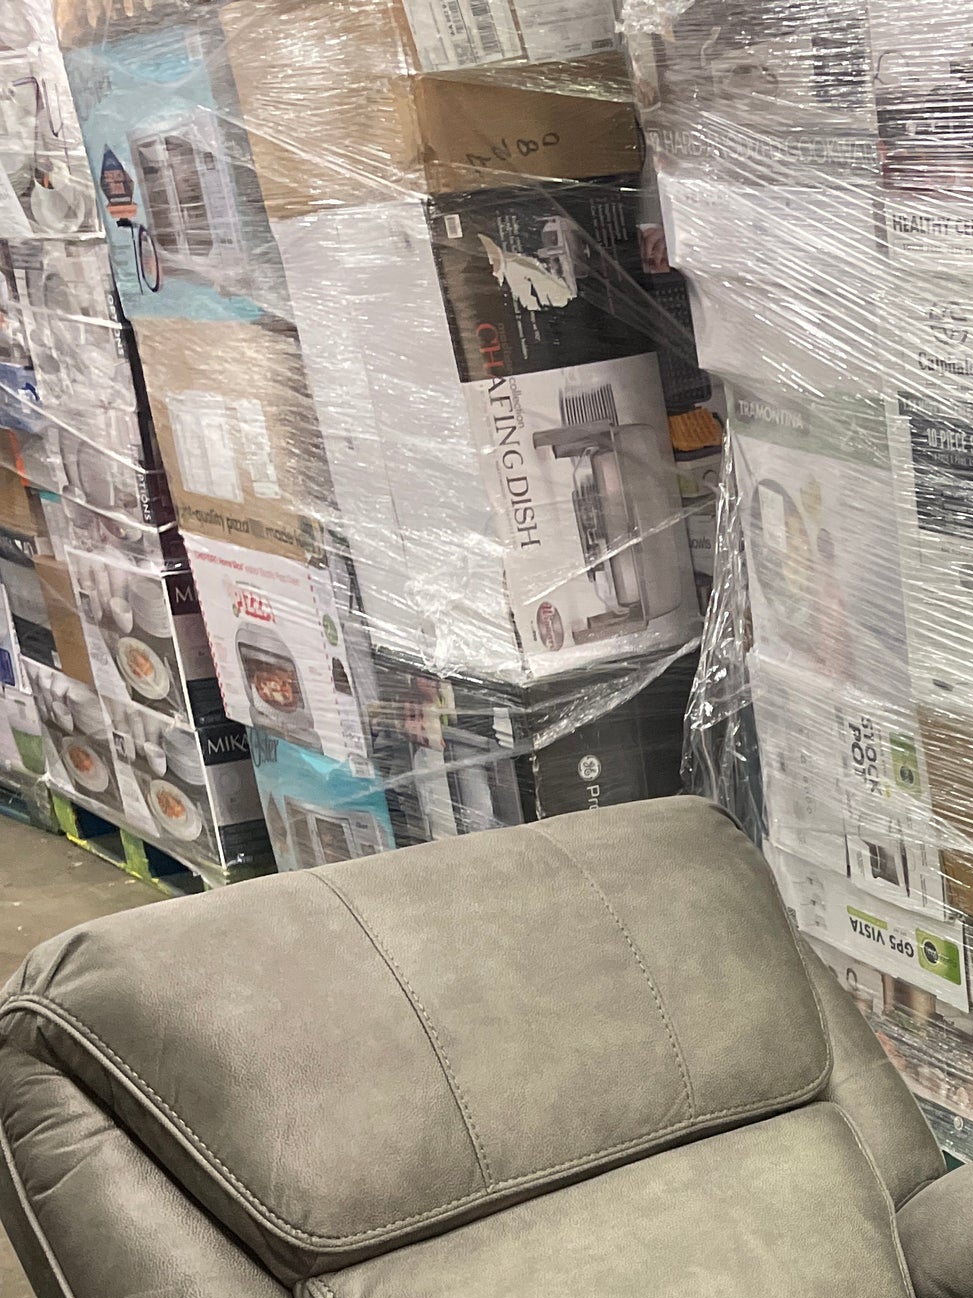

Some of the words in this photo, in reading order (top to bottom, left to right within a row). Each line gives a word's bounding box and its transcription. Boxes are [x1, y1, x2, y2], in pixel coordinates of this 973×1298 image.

[508, 377, 525, 429] collection
[476, 322, 525, 470] CHAFING
[506, 474, 541, 549] DISH
[137, 471, 151, 521] PTIONS
[848, 722, 867, 784] POT
[849, 916, 886, 946] VISTA
